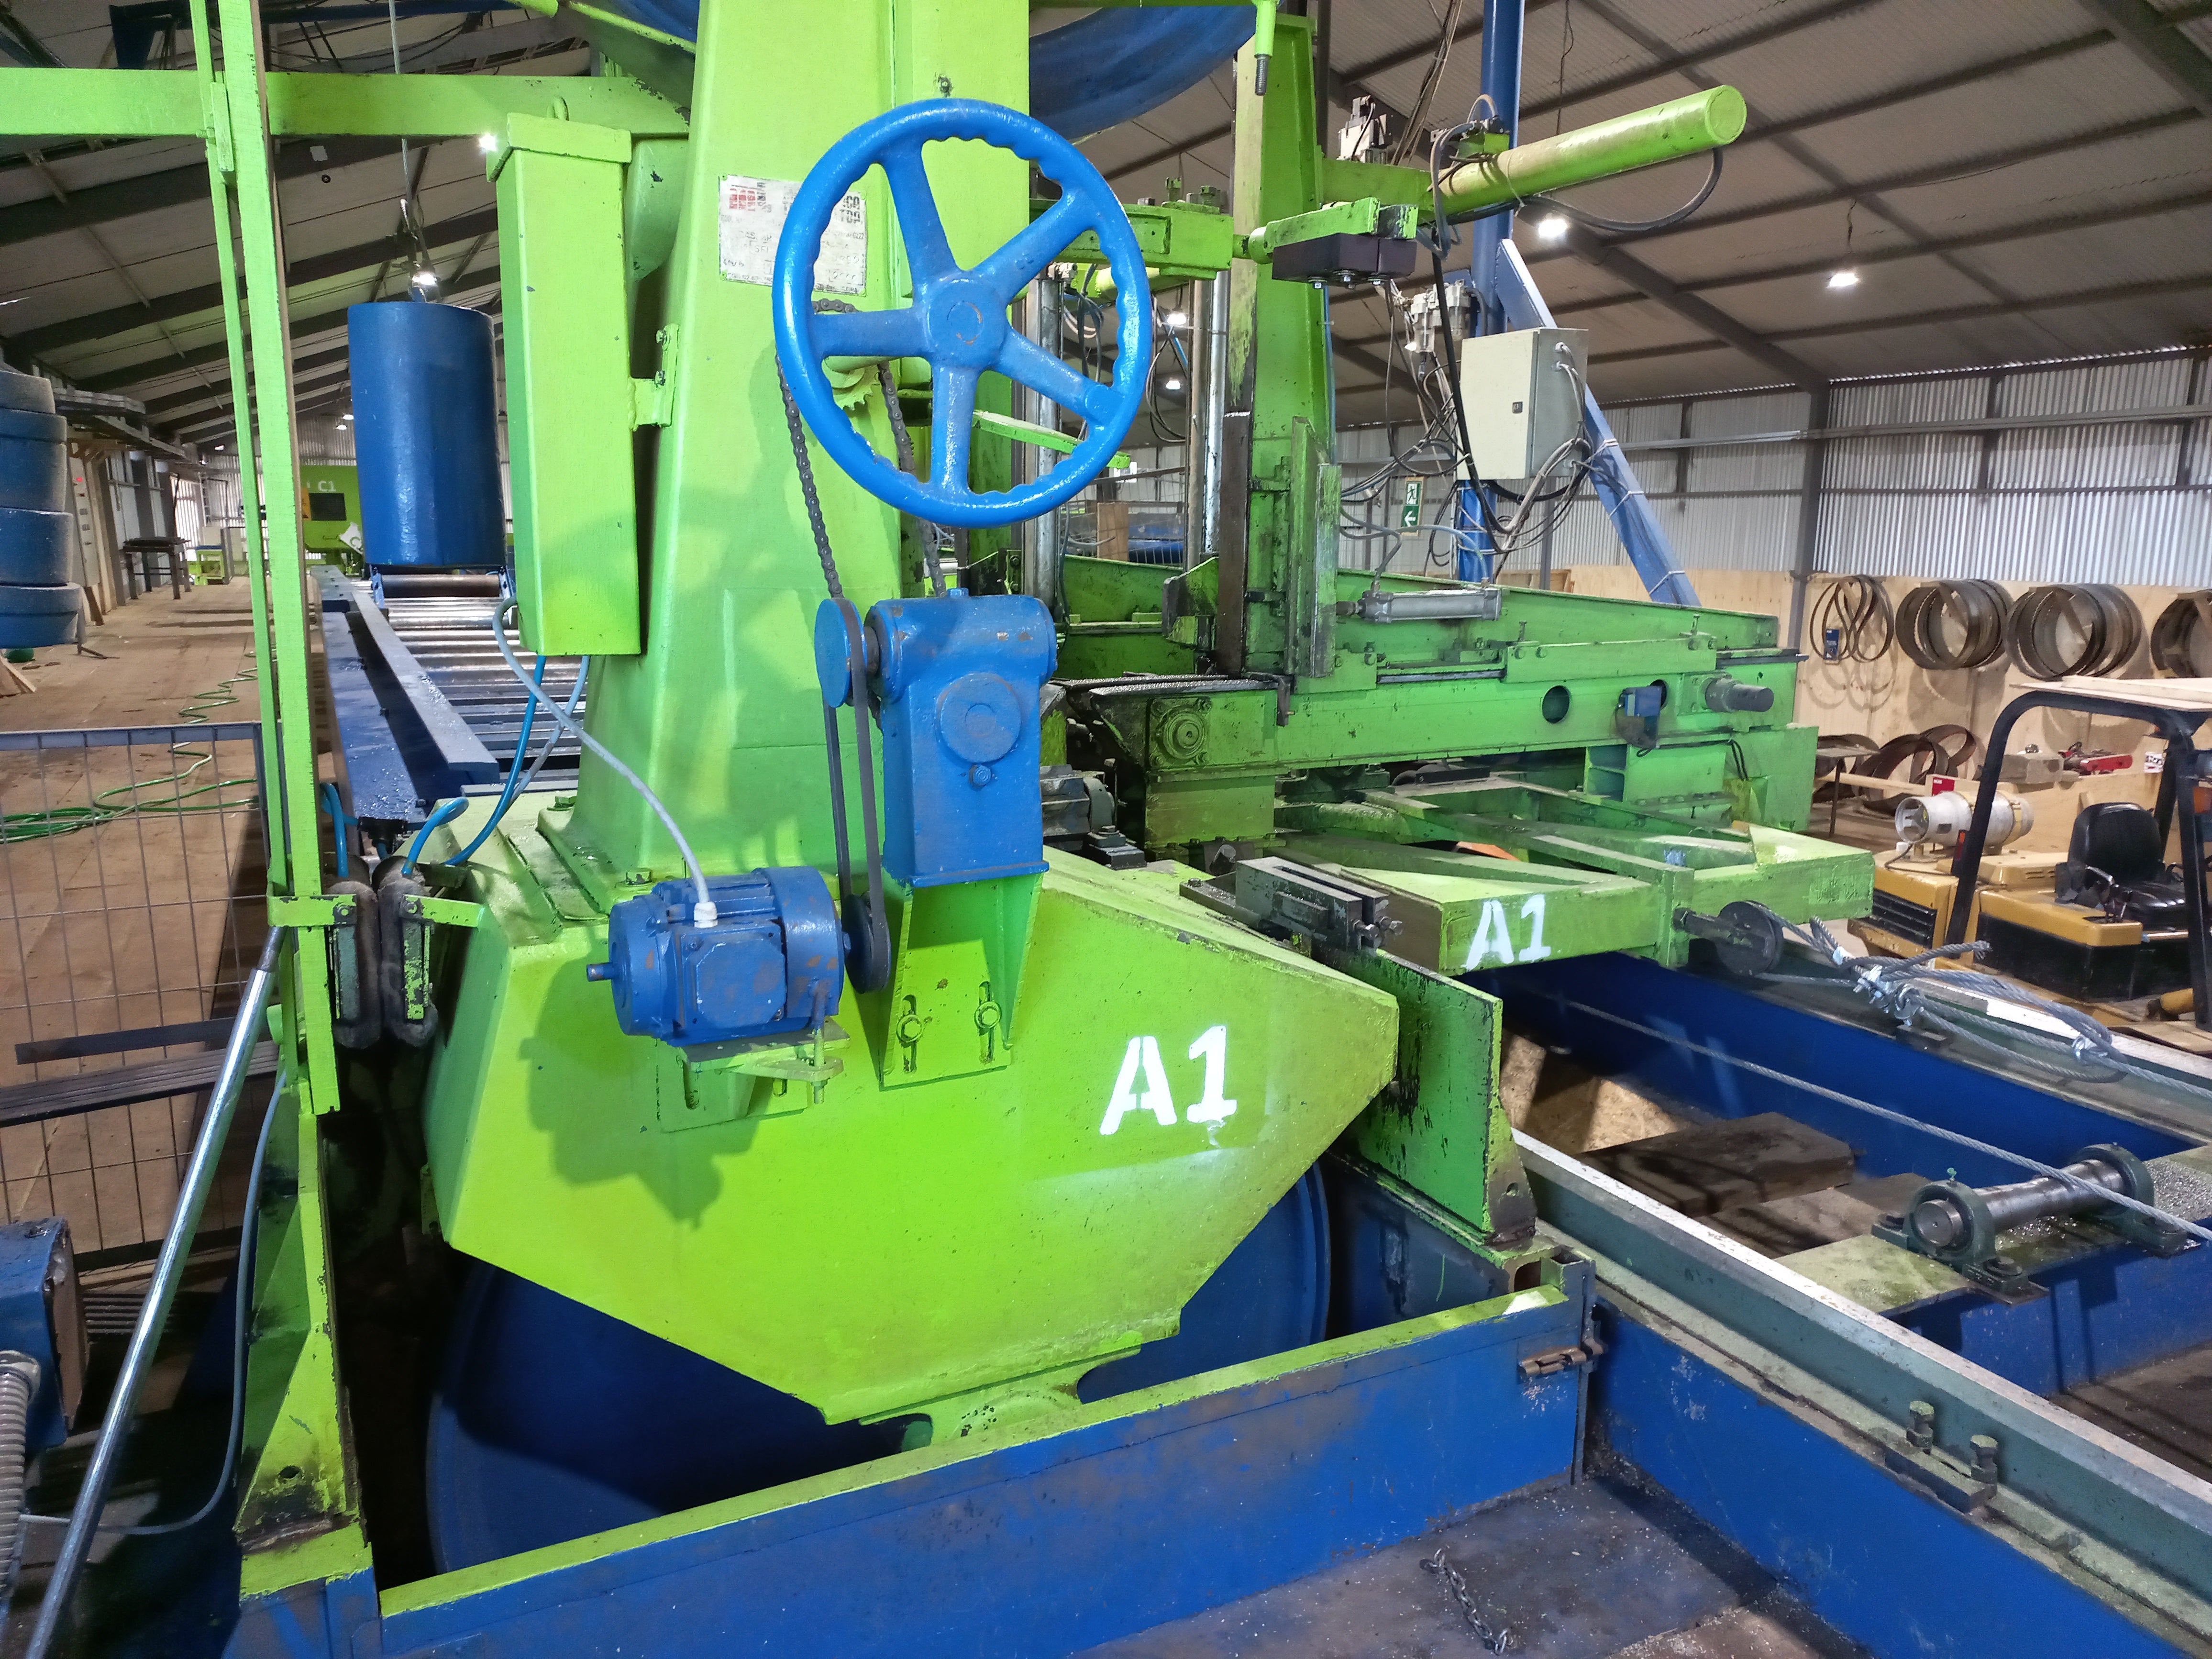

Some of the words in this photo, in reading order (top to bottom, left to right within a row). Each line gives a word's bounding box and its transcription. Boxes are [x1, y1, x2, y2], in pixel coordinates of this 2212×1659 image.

[318, 480, 336, 492] C1
[1465, 894, 1551, 972] A1
[1100, 1025, 1238, 1135] A1
